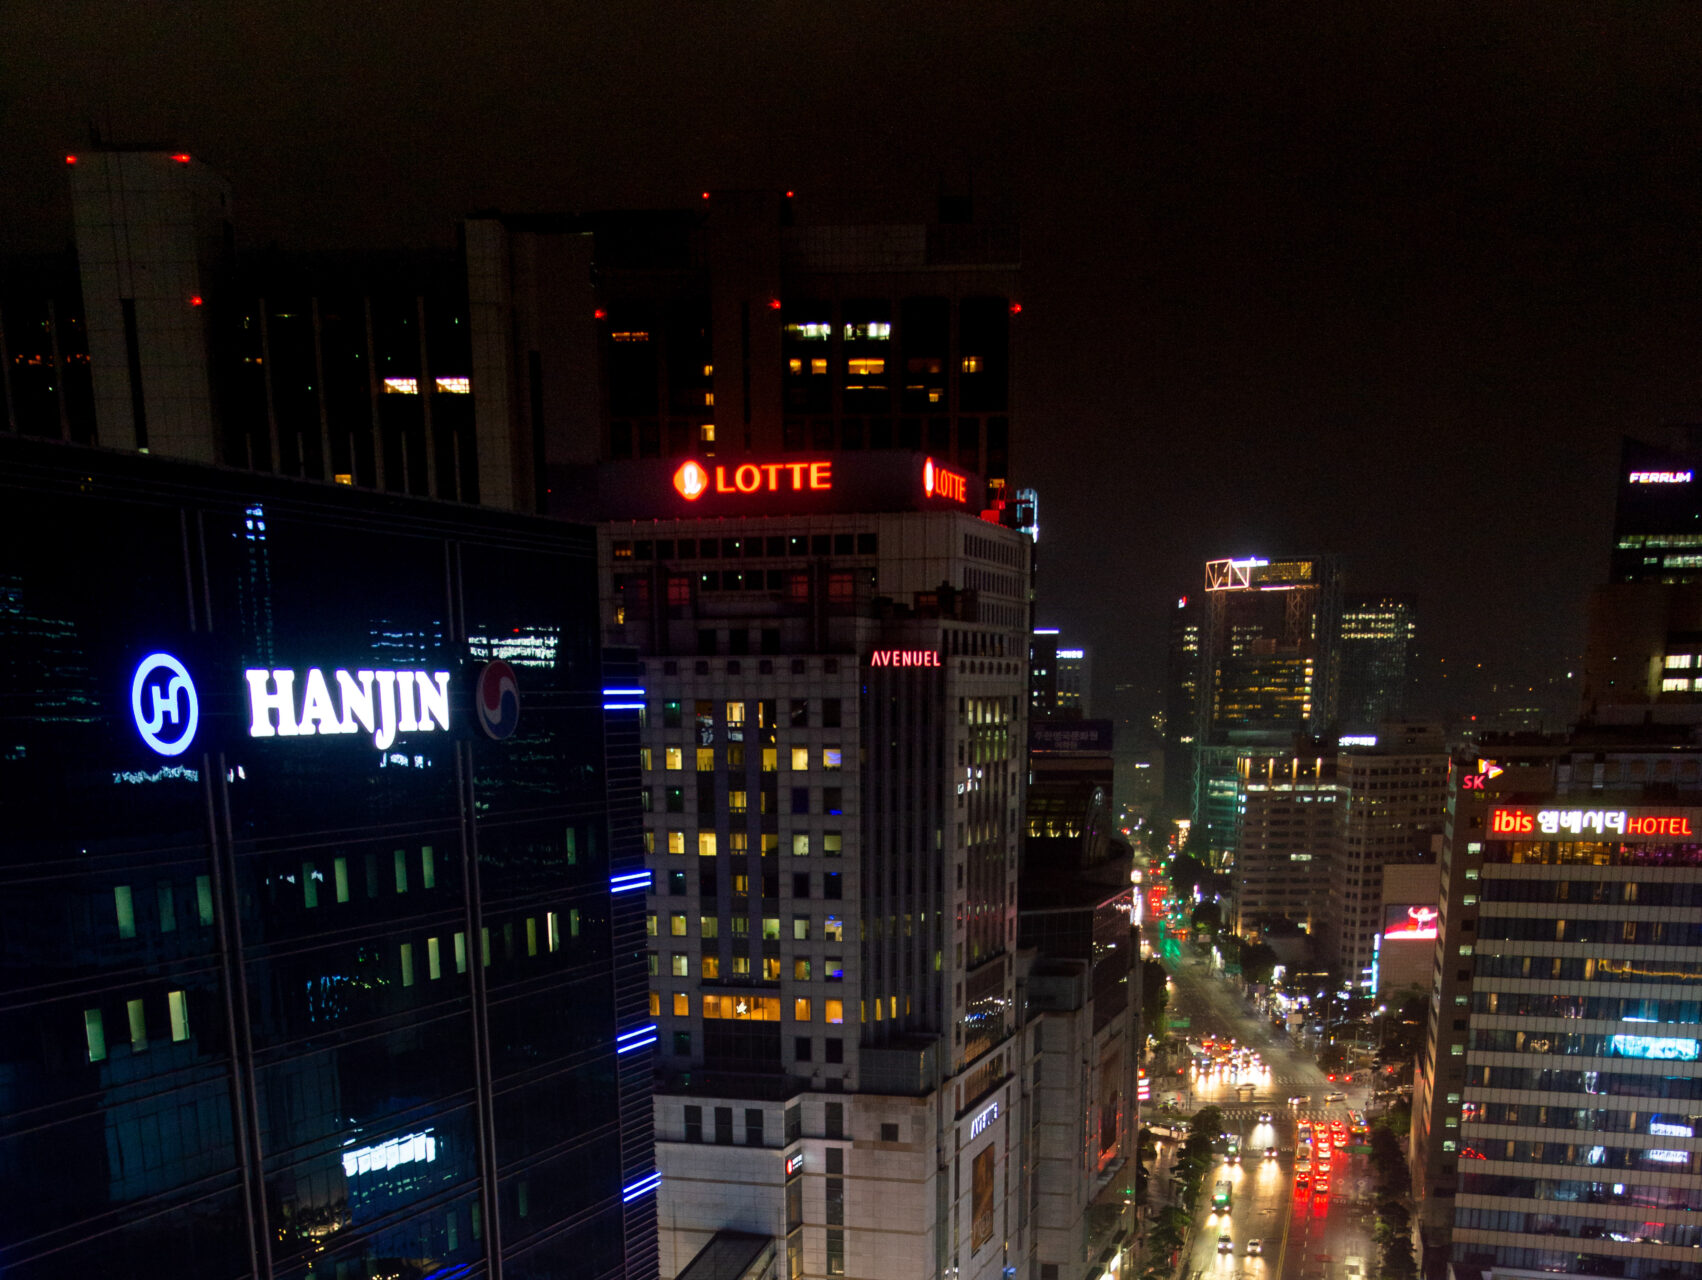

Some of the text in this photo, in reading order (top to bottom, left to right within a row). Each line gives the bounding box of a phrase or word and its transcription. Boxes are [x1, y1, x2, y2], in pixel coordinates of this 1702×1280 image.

[716, 462, 832, 493] LOTTE
[934, 468, 966, 502] LOTTE
[1629, 472, 1691, 483] FERRUM
[871, 650, 941, 667] AVENUEL
[246, 668, 450, 750] HANJIN
[1462, 775, 1486, 790] SK
[1493, 810, 1533, 832] ibis
[1627, 817, 1692, 836] HOTEL
